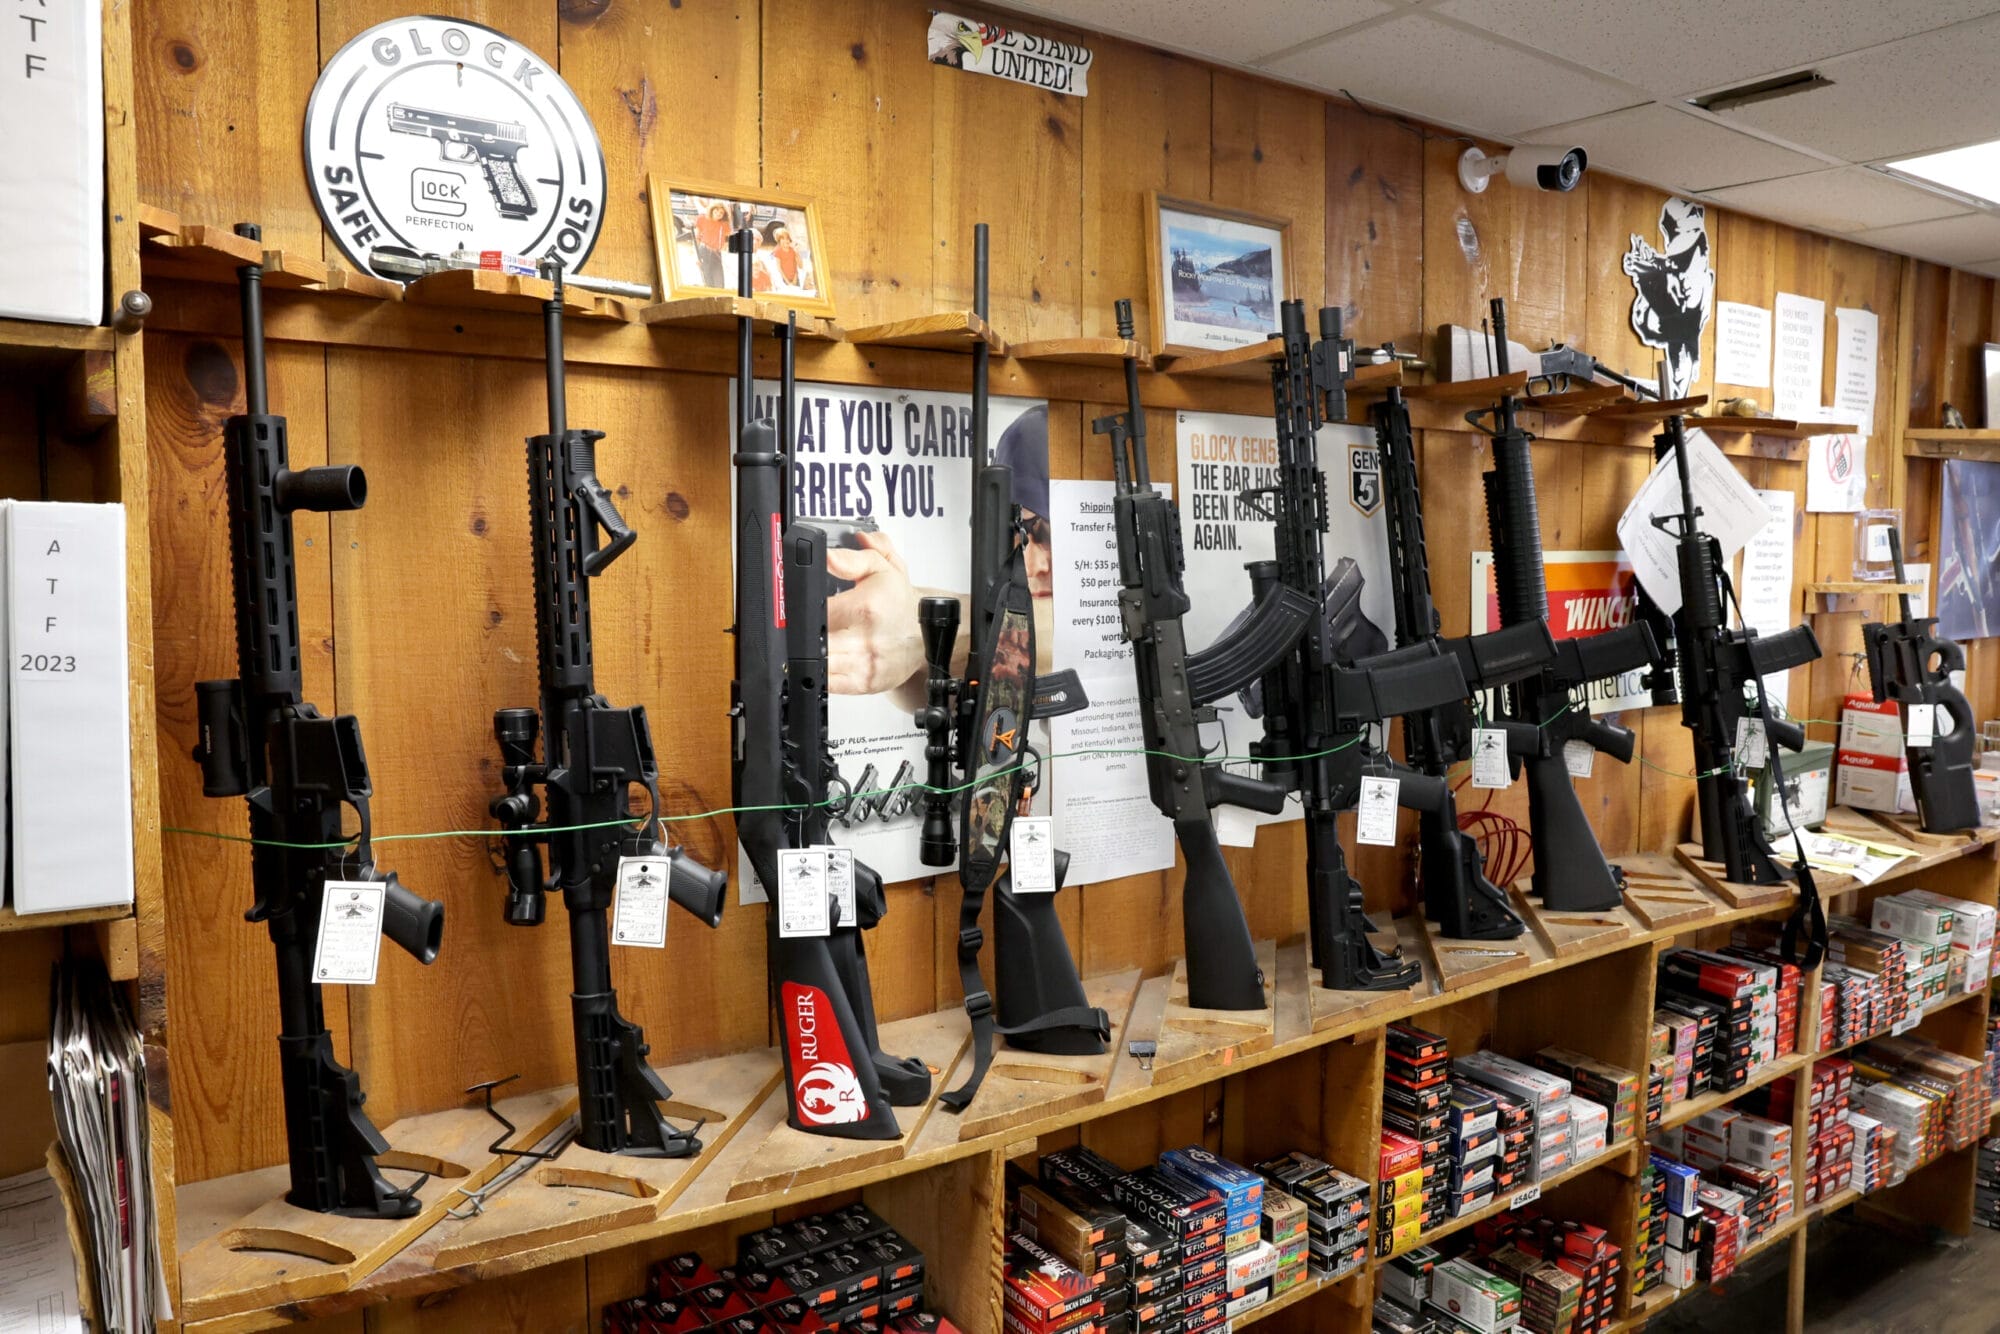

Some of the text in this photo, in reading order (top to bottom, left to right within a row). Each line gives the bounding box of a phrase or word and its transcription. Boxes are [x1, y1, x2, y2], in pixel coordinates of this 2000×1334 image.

[371, 28, 543, 92] GLOCK
[991, 46, 1074, 93] UNITED!
[323, 164, 381, 249] SAFE
[405, 215, 475, 233] PERFECTION
[840, 399, 893, 455] YOU
[904, 402, 994, 459] CARR,
[1191, 432, 1238, 462] GLOCK
[1352, 450, 1379, 470] GEN
[1191, 463, 1282, 492] THE BAR HAS
[794, 462, 945, 518] RRIES YOU.
[1358, 474, 1375, 506] 5
[1192, 494, 1276, 522] BEEN RAISE
[1070, 522, 1117, 532] Transfer Fe
[1193, 523, 1242, 551] AGAIN.
[1105, 541, 1117, 550] Gu
[1074, 560, 1093, 571] S/H:
[1094, 560, 1109, 571] $35
[1080, 578, 1096, 588] $50
[1097, 580, 1111, 590] per
[1072, 616, 1094, 627] every
[1096, 615, 1115, 625] $100
[1564, 595, 1639, 632] WINCH
[20, 654, 76, 673] 2023
[1084, 649, 1126, 661] Packaging:
[1091, 698, 1132, 708] Non-resident
[1848, 699, 1881, 711] Aguila
[1075, 711, 1115, 723] surrounding
[1116, 711, 1133, 720] states
[1071, 739, 1083, 749] and
[1084, 736, 1116, 749] Kentucky)
[1117, 735, 1131, 745] with
[1105, 763, 1128, 771] ammo.
[1842, 754, 1875, 766] Aguila
[320, 968, 328, 977] $
[797, 991, 819, 1061] RUGER
[1048, 1153, 1102, 1188] FIOCCHI
[1117, 1175, 1179, 1209] FIOCCHI
[1125, 1191, 1182, 1233] FIOCCHI
[1009, 1233, 1075, 1276] AMERICAN EAGLE
[1079, 1295, 1093, 1306] EAGLE
[1027, 1301, 1043, 1321] EAGLE
